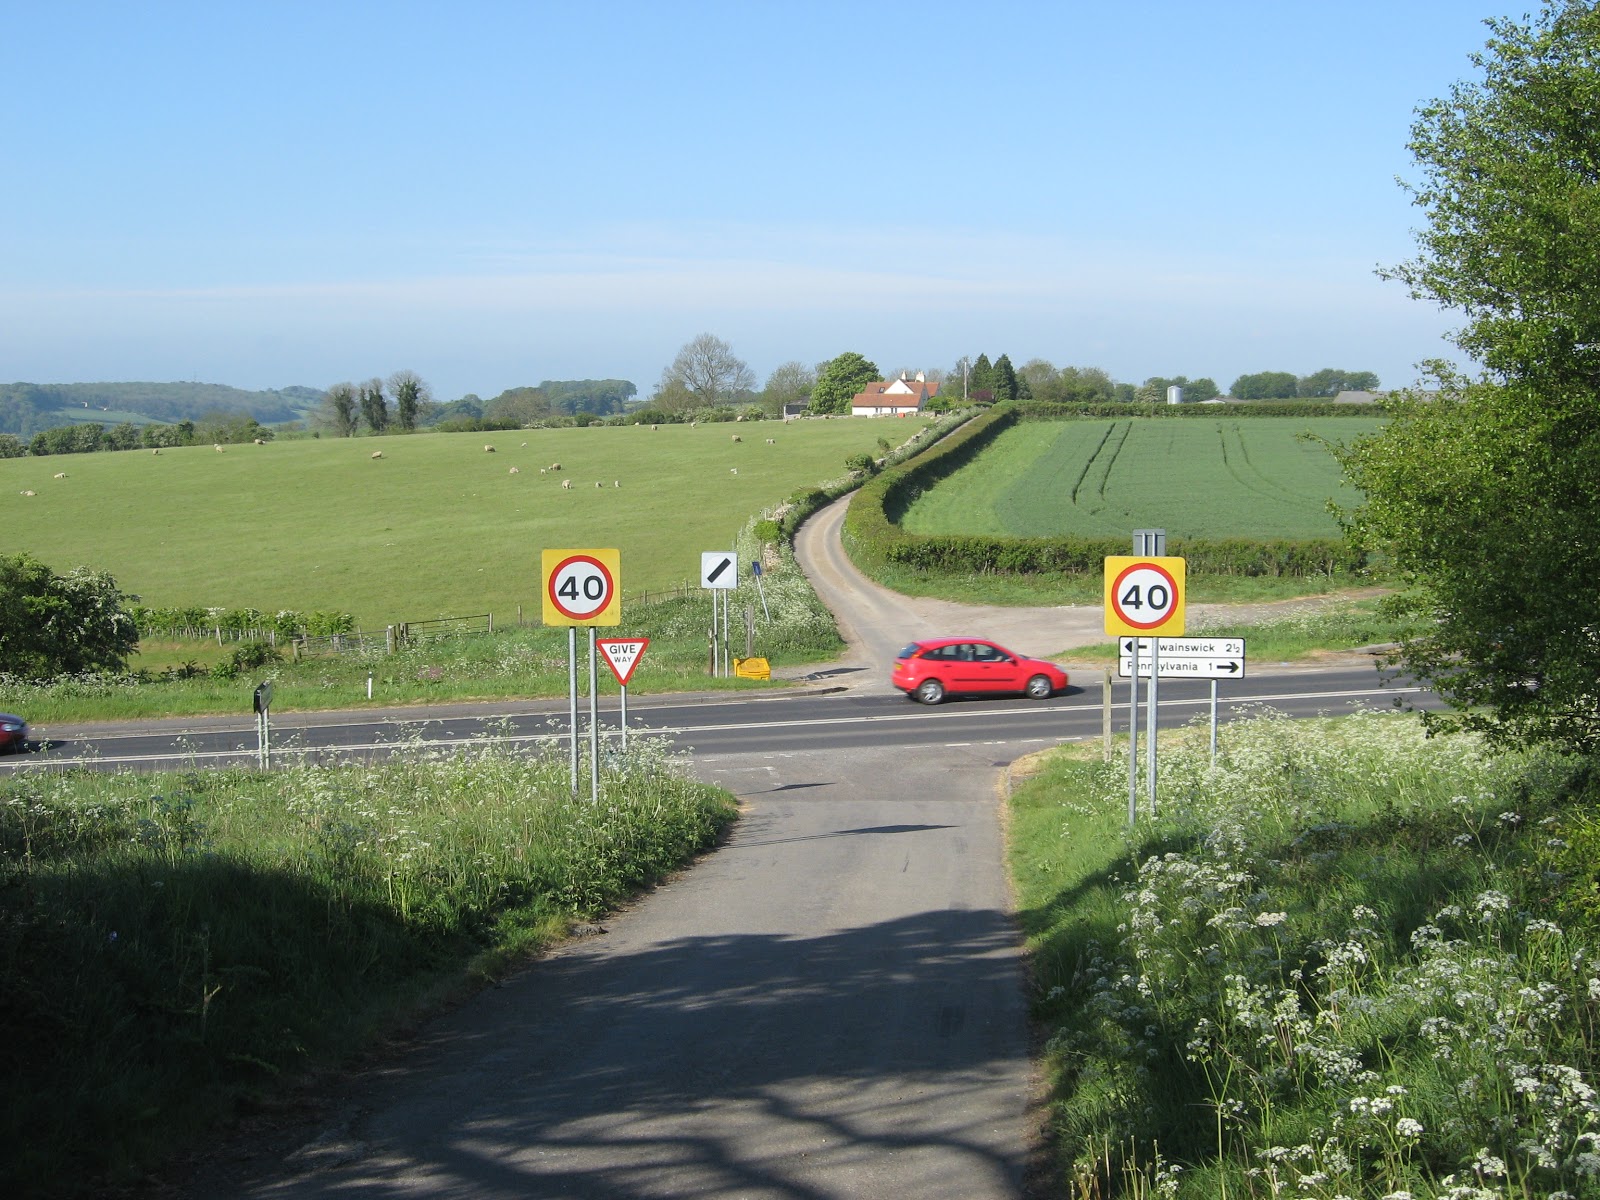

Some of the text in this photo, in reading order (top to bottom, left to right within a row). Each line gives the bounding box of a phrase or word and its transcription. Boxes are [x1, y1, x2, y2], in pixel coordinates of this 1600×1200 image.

[558, 575, 604, 601] 40
[1121, 584, 1169, 610] 40
[609, 644, 636, 654] GIVE
[1157, 642, 1215, 653] wainswick
[1208, 662, 1213, 671] 1
